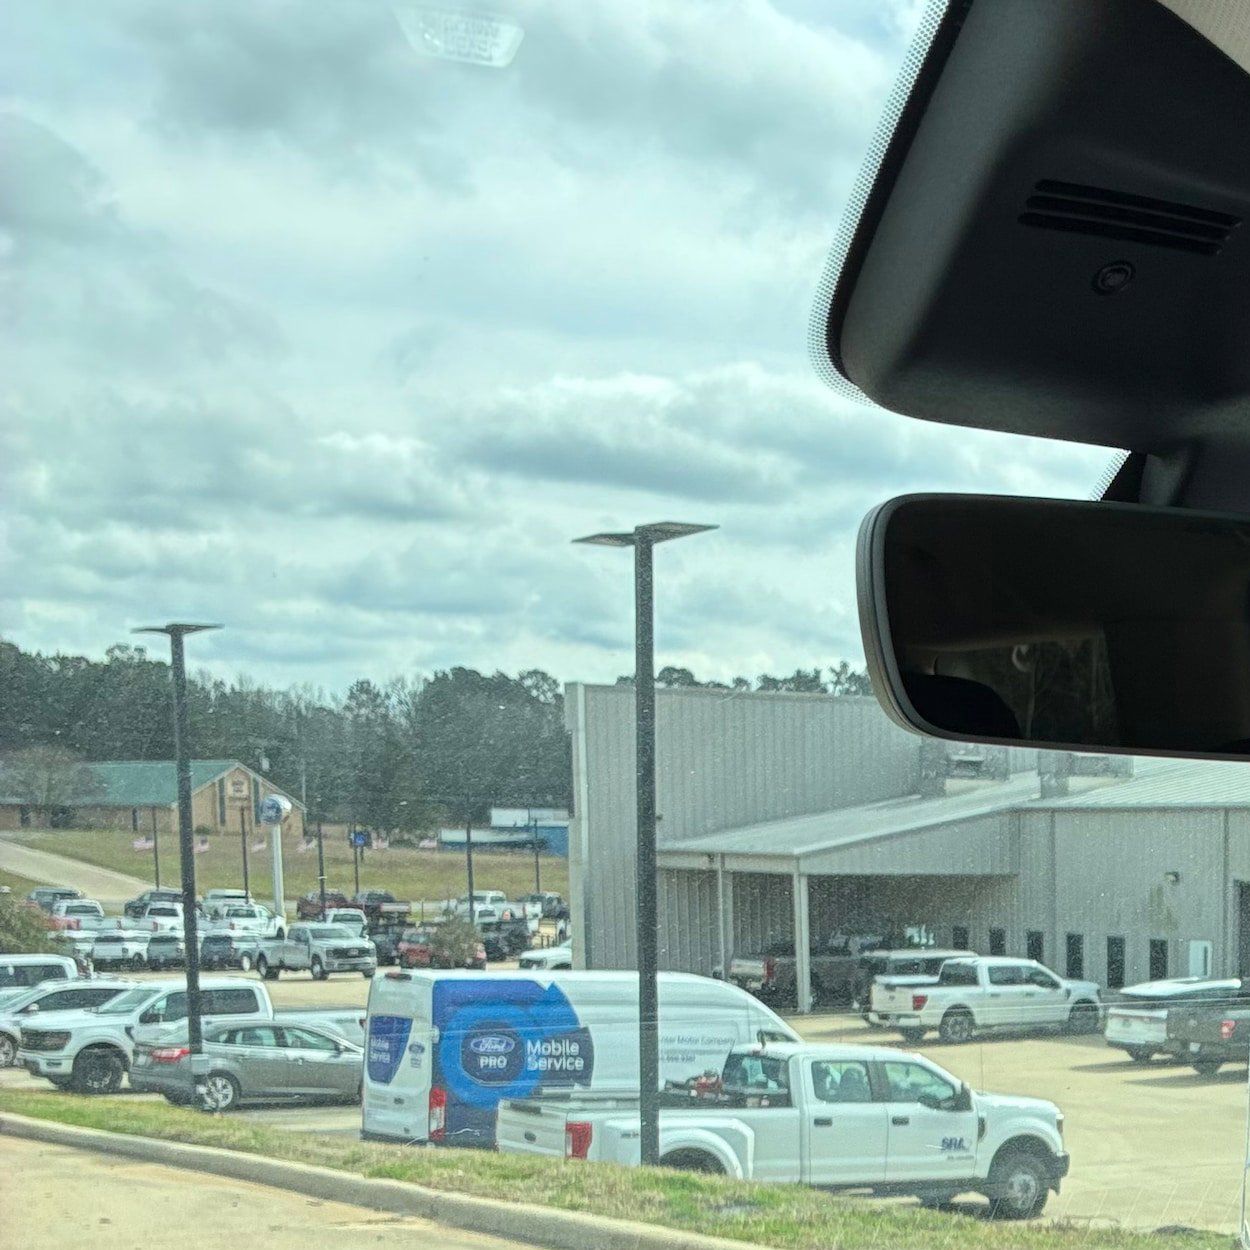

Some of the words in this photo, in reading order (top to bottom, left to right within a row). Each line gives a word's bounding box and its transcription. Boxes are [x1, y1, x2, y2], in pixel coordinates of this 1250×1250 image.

[527, 1039, 579, 1055] Mobile
[480, 1056, 507, 1068] PRO
[527, 1054, 584, 1070] Service
